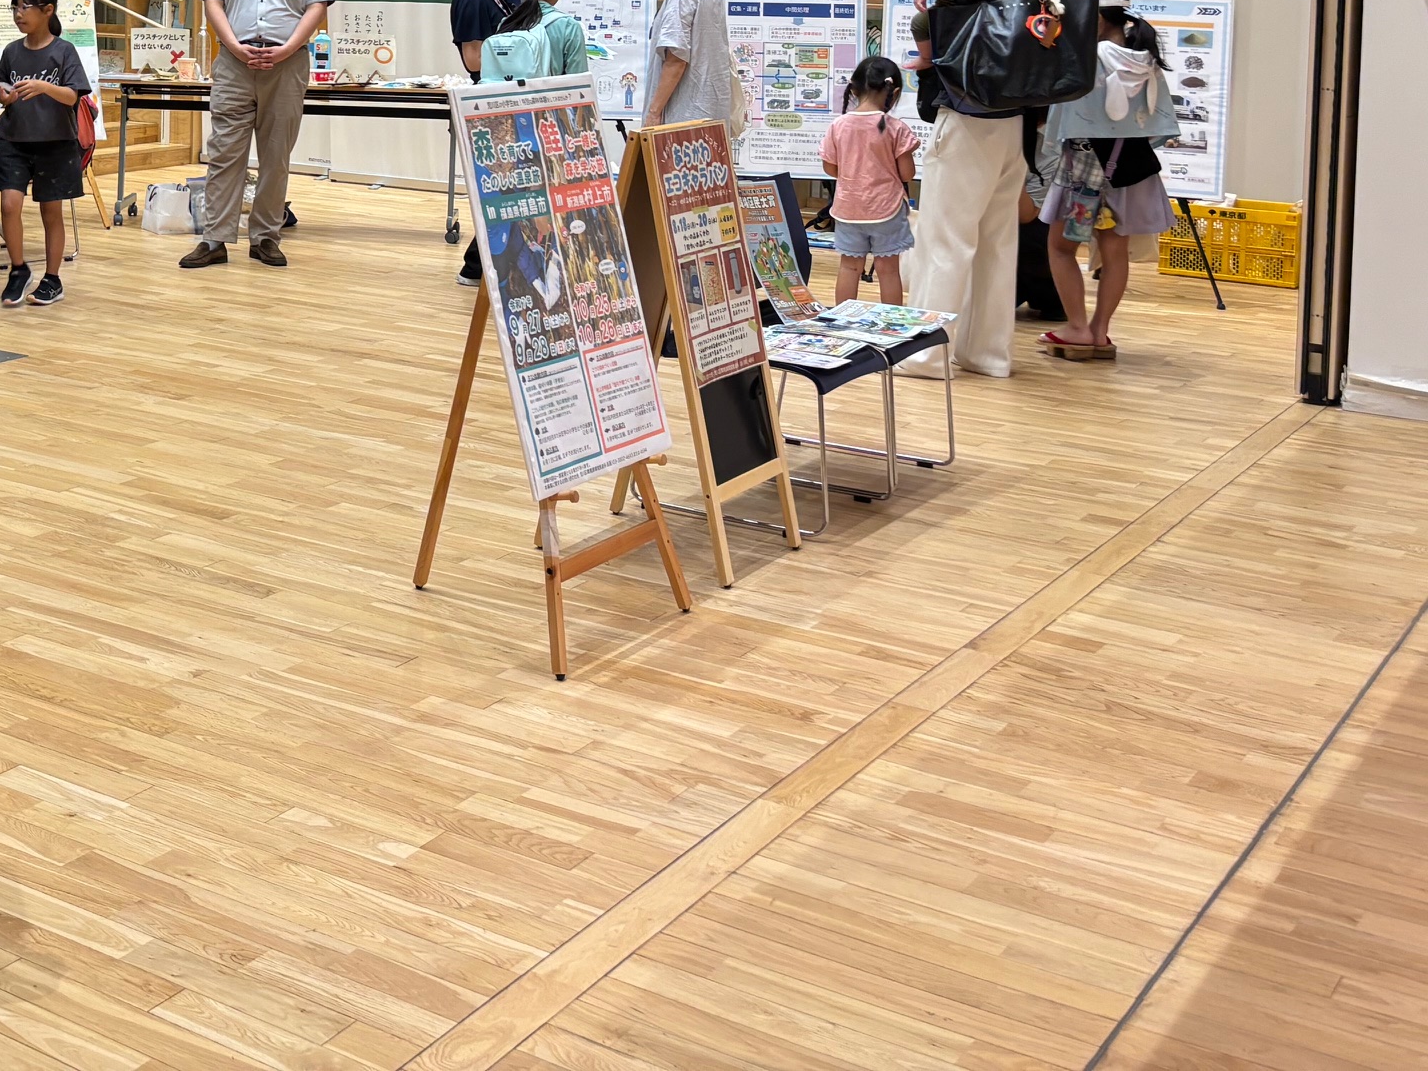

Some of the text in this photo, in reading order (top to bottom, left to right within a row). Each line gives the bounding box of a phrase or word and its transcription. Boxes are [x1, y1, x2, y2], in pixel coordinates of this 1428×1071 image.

[134, 33, 186, 42] プラスチックとして
[134, 43, 172, 51] 出せないもの
[337, 38, 392, 46] プラスチックとして
[673, 139, 711, 169] あらかわ
[564, 156, 607, 179] 森を学ぶ旅
[481, 167, 542, 193] たのしい温泉旅
[663, 162, 728, 197] エコキャラバン
[554, 185, 612, 209] in 新潟県村上市
[486, 197, 547, 221] in 福島県福島市
[1220, 210, 1247, 220] 東京都
[683, 229, 710, 241] ゆいの森あらかわ
[508, 295, 534, 312] 令和7年
